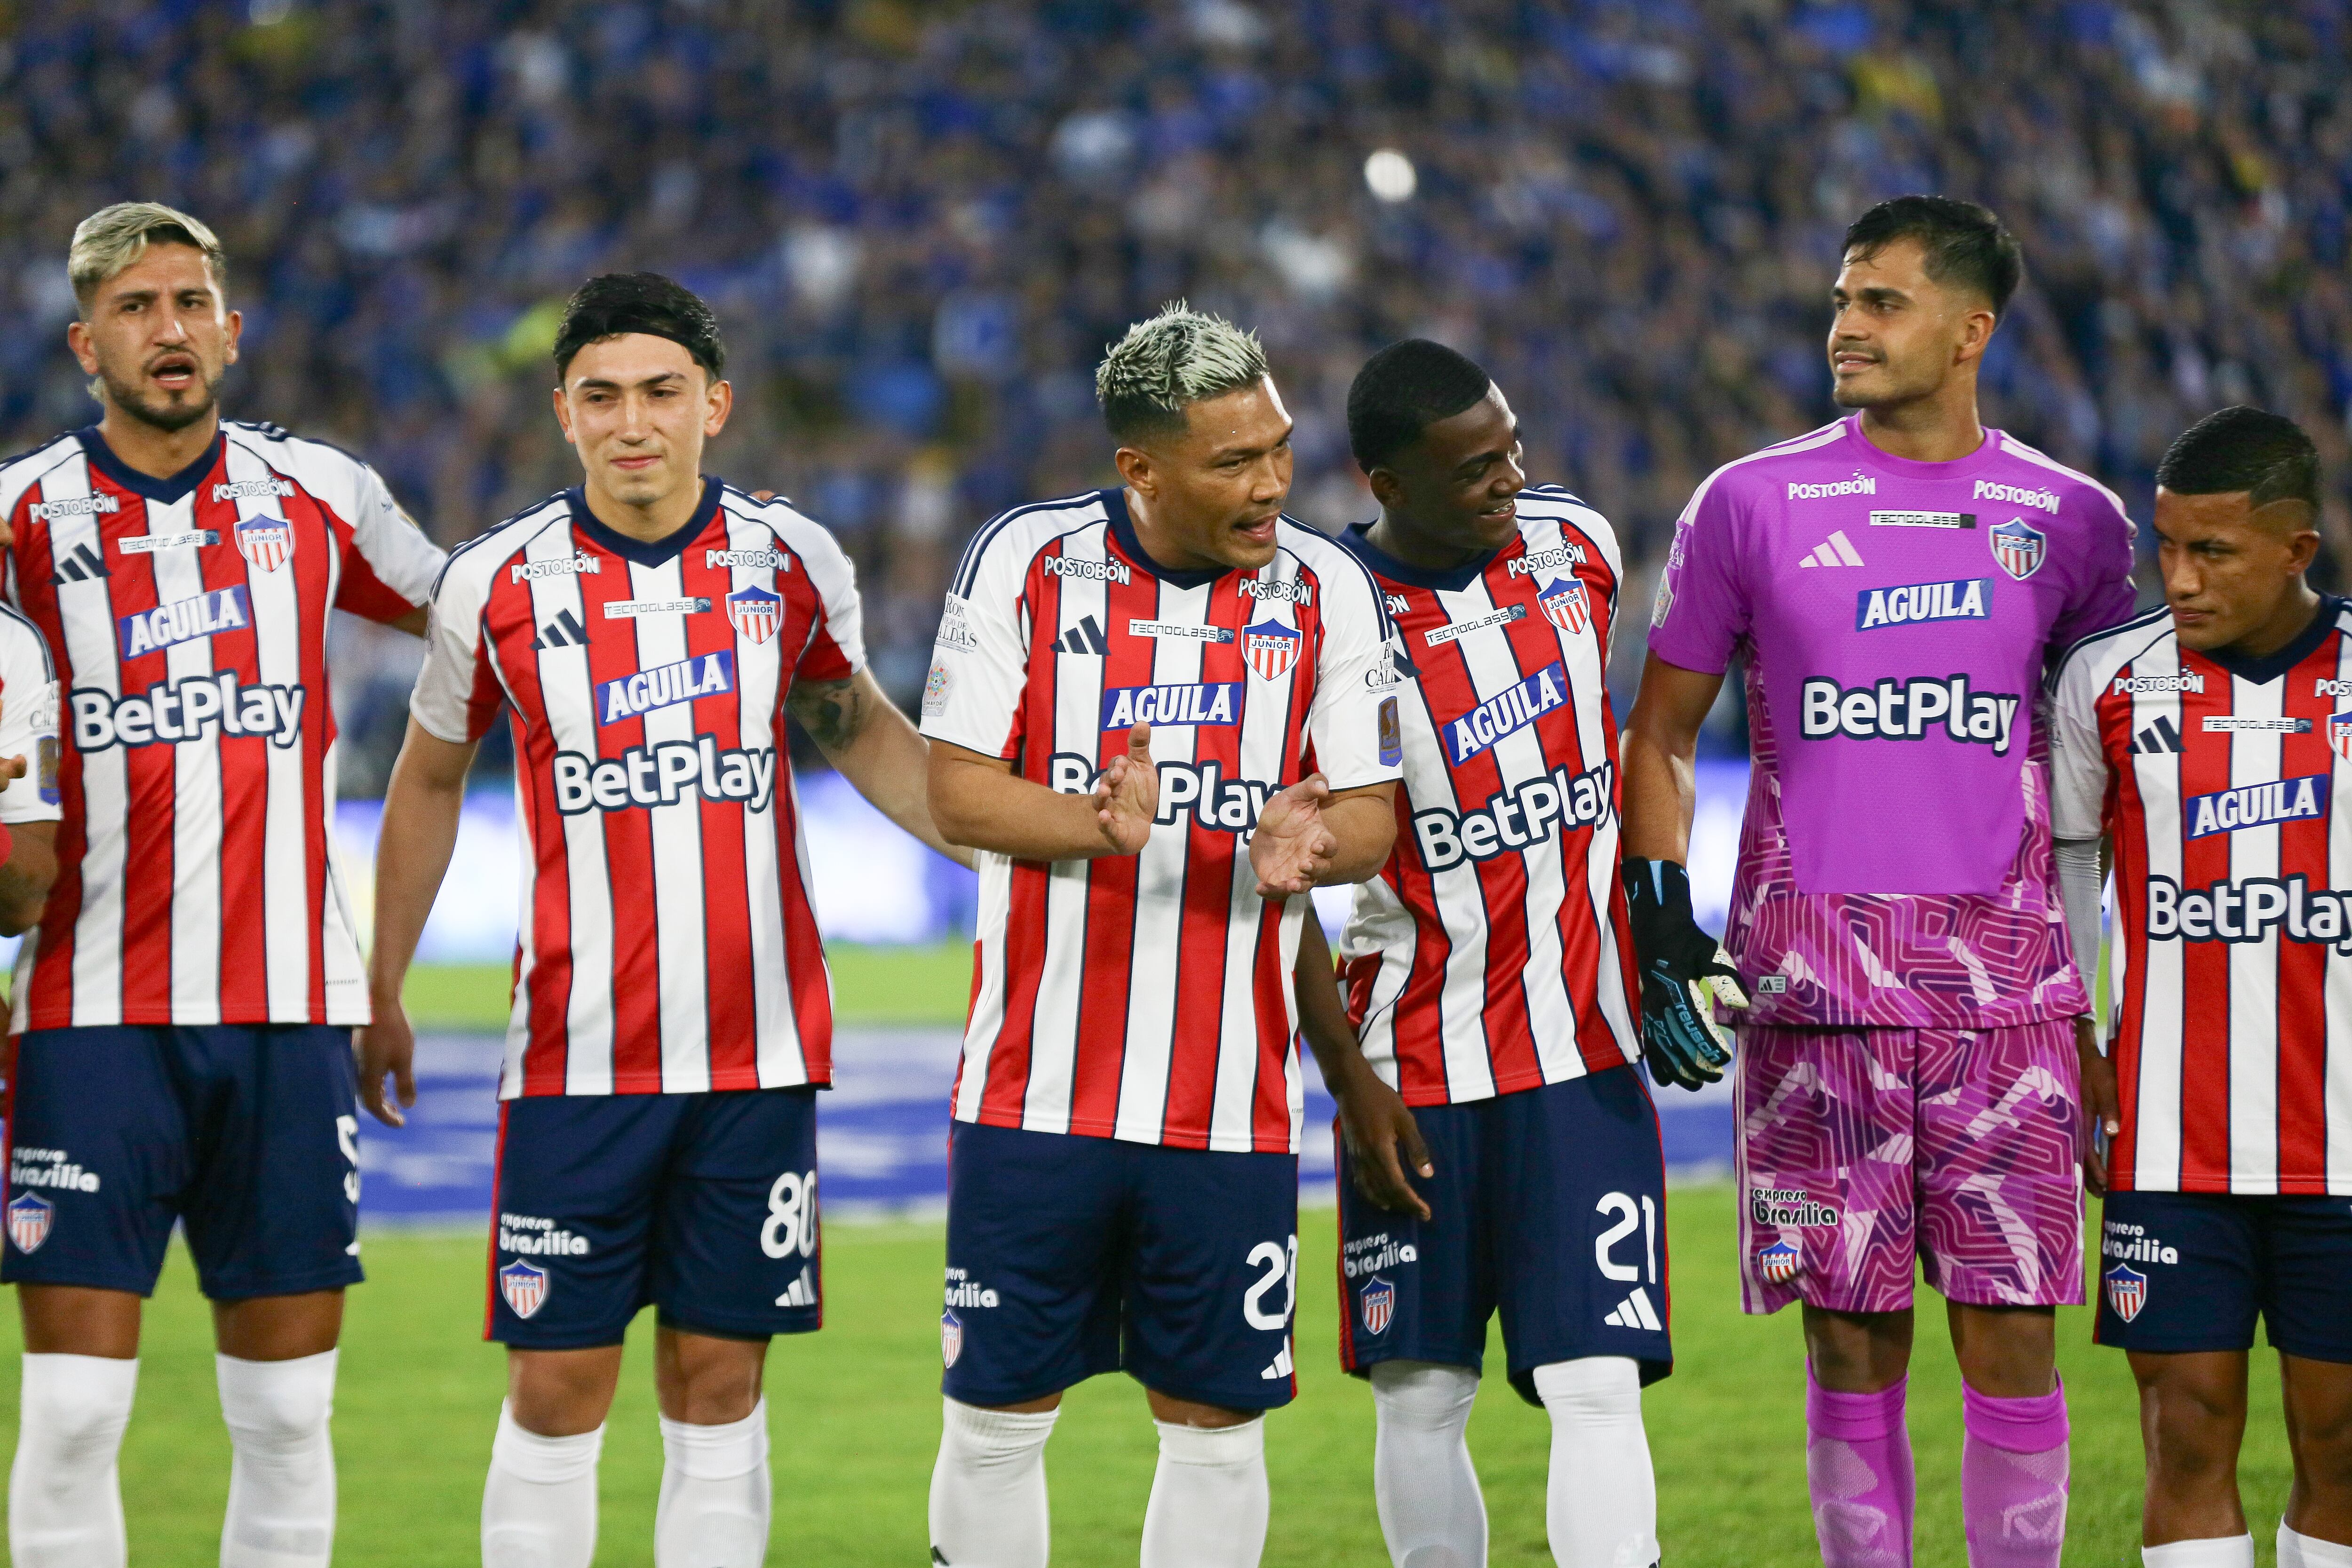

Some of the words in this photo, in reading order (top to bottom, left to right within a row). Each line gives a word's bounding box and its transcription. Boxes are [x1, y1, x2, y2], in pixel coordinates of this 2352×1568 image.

[245, 534, 282, 542] JUNIOR
[128, 589, 244, 657] AGUILA
[1550, 594, 1579, 610] JUNIOR
[1861, 581, 1985, 629] AGUILA
[938, 625, 977, 647] LDAS
[1252, 640, 1290, 649] JUNIOR
[71, 670, 304, 751] BetPlay
[605, 654, 727, 723] AGUILA
[1107, 684, 1233, 728] AGUILA
[1457, 669, 1564, 762] AGUILA
[1800, 674, 2019, 757] BetPlay
[553, 733, 775, 814] BetPlay
[1049, 753, 1288, 841] BPla
[1413, 759, 1614, 872] BetPlay
[2192, 777, 2318, 837] AGUILA
[1676, 1004, 1720, 1062] reusch
[761, 1170, 815, 1258] 80
[1753, 1189, 1807, 1203] expreso
[1754, 1201, 1837, 1226] brasilia
[499, 1226, 590, 1255] brasilia
[1344, 1241, 1417, 1278] brasilia
[1595, 1192, 1656, 1284] 21
[945, 1282, 999, 1308] asilia
